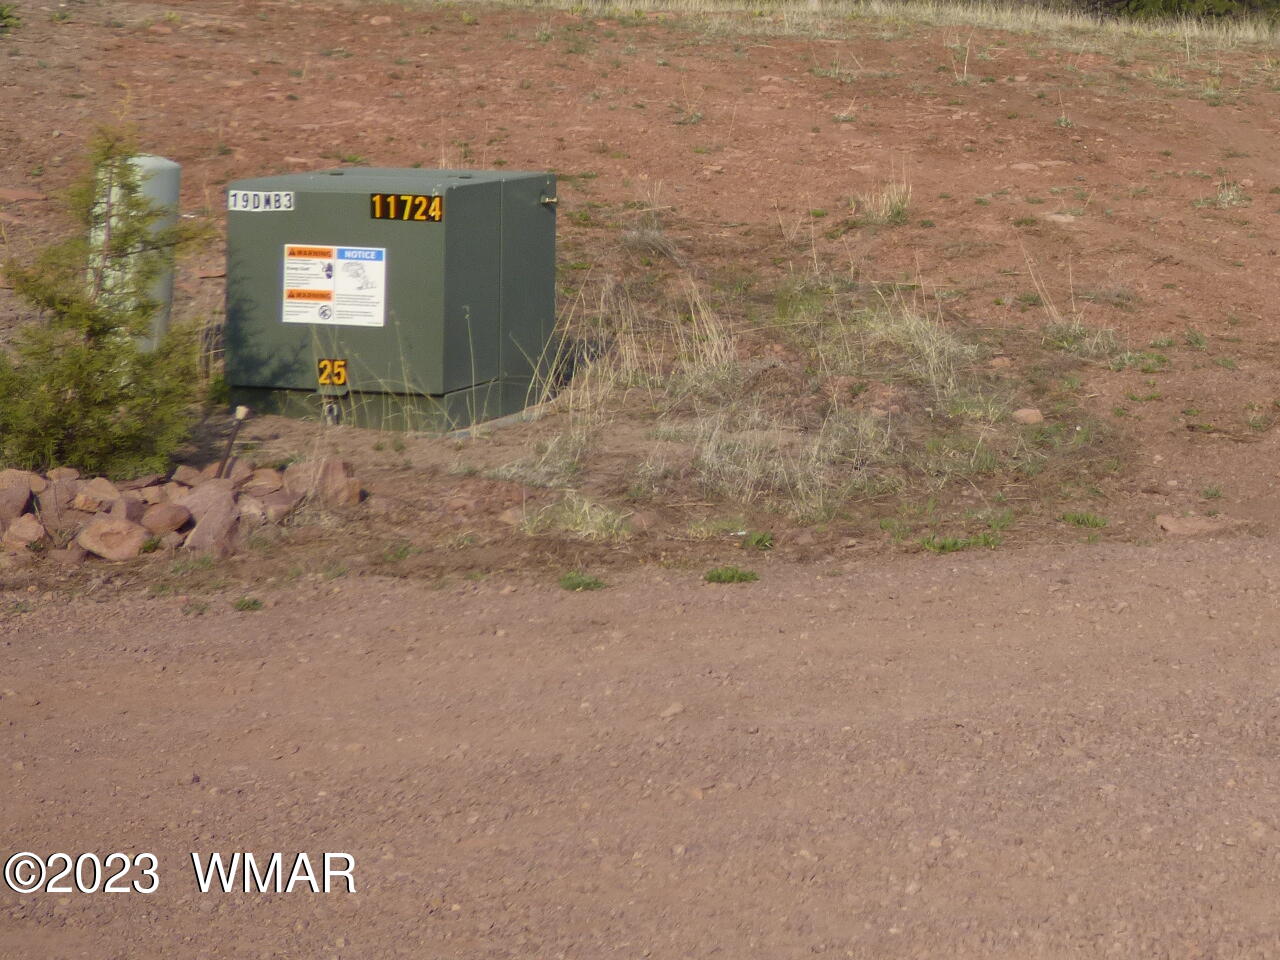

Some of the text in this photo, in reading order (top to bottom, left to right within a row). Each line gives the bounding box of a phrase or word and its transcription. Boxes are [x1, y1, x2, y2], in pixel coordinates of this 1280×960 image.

[372, 194, 442, 221] 11724
[344, 250, 376, 259] NOTICE
[319, 359, 346, 385] 25
